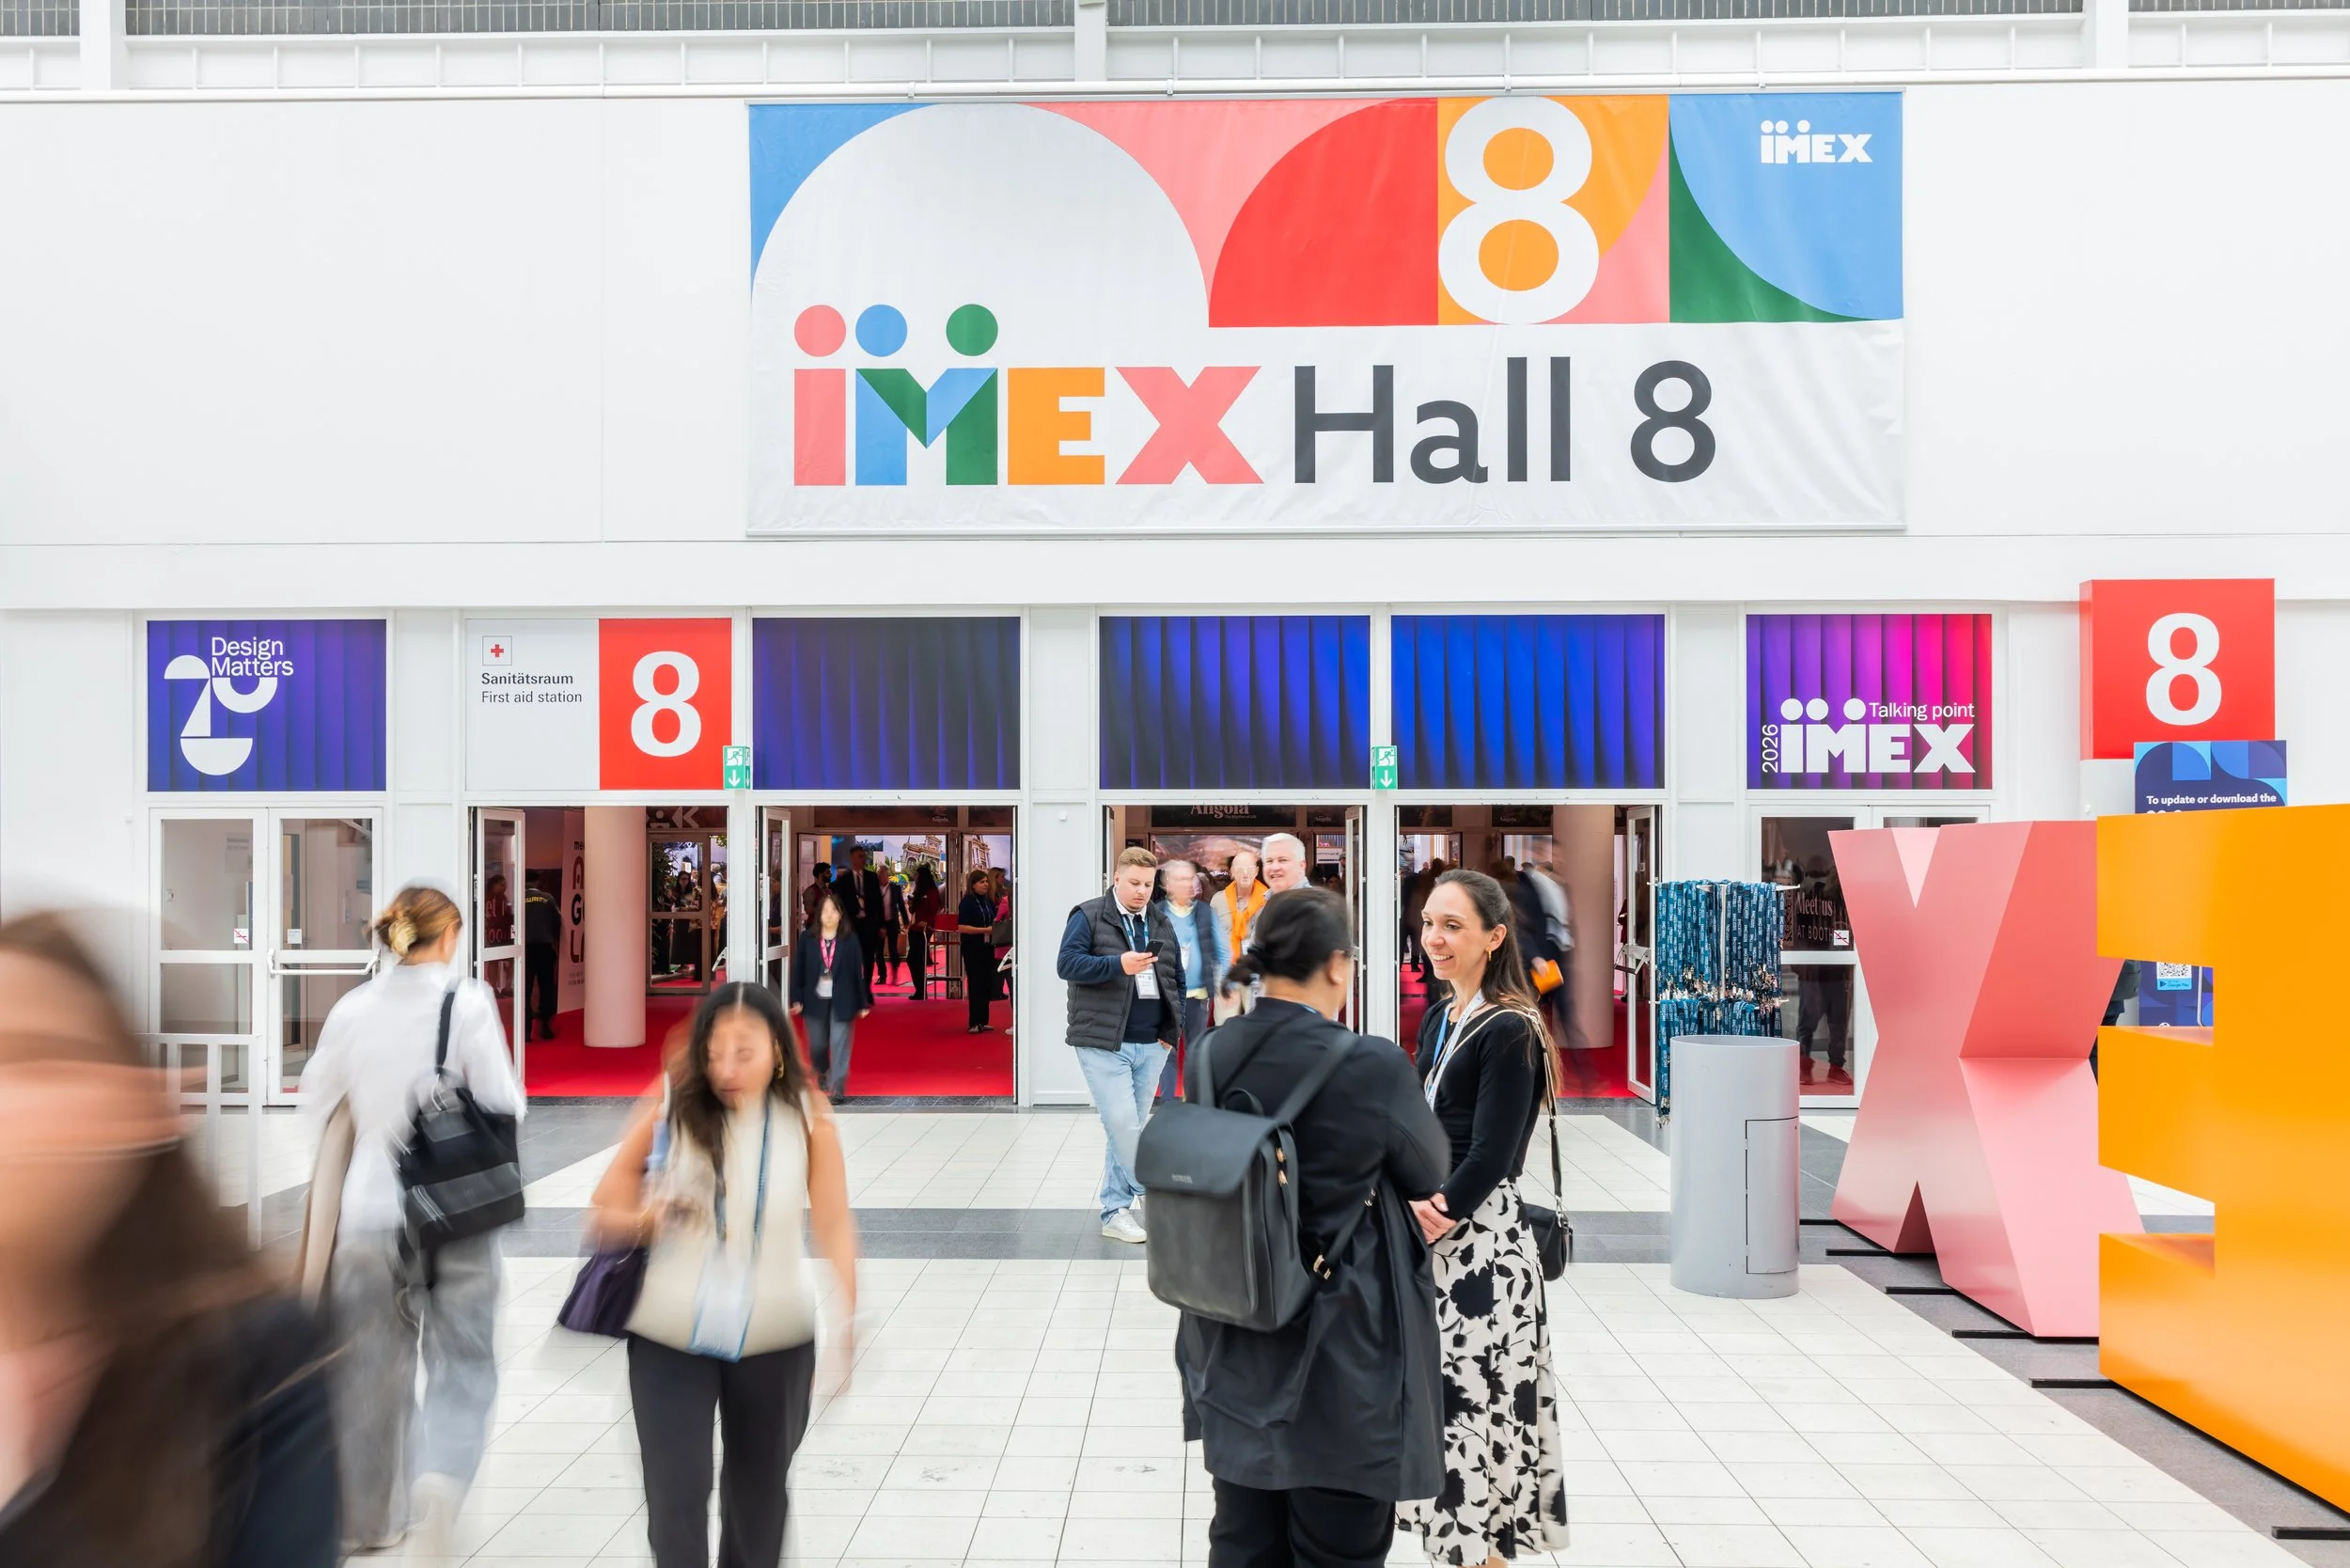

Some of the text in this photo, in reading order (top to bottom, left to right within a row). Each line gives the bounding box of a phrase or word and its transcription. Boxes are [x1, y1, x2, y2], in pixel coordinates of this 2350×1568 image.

[1438, 96, 1600, 325] 8
[1294, 356, 1571, 484] Hall
[1630, 359, 1716, 483] 8
[212, 636, 284, 661] Design
[212, 656, 294, 677] Matters
[481, 671, 573, 685] Sanitätsraum
[2145, 612, 2221, 726] 8
[481, 691, 583, 703] First aid station
[631, 651, 702, 758] 8
[1869, 701, 1975, 721] Talking point
[1762, 723, 1778, 774] 2026
[2146, 792, 2277, 807] To update or download the
[1797, 891, 1833, 917] Meet us
[1797, 924, 1834, 942] AT BOOTH
